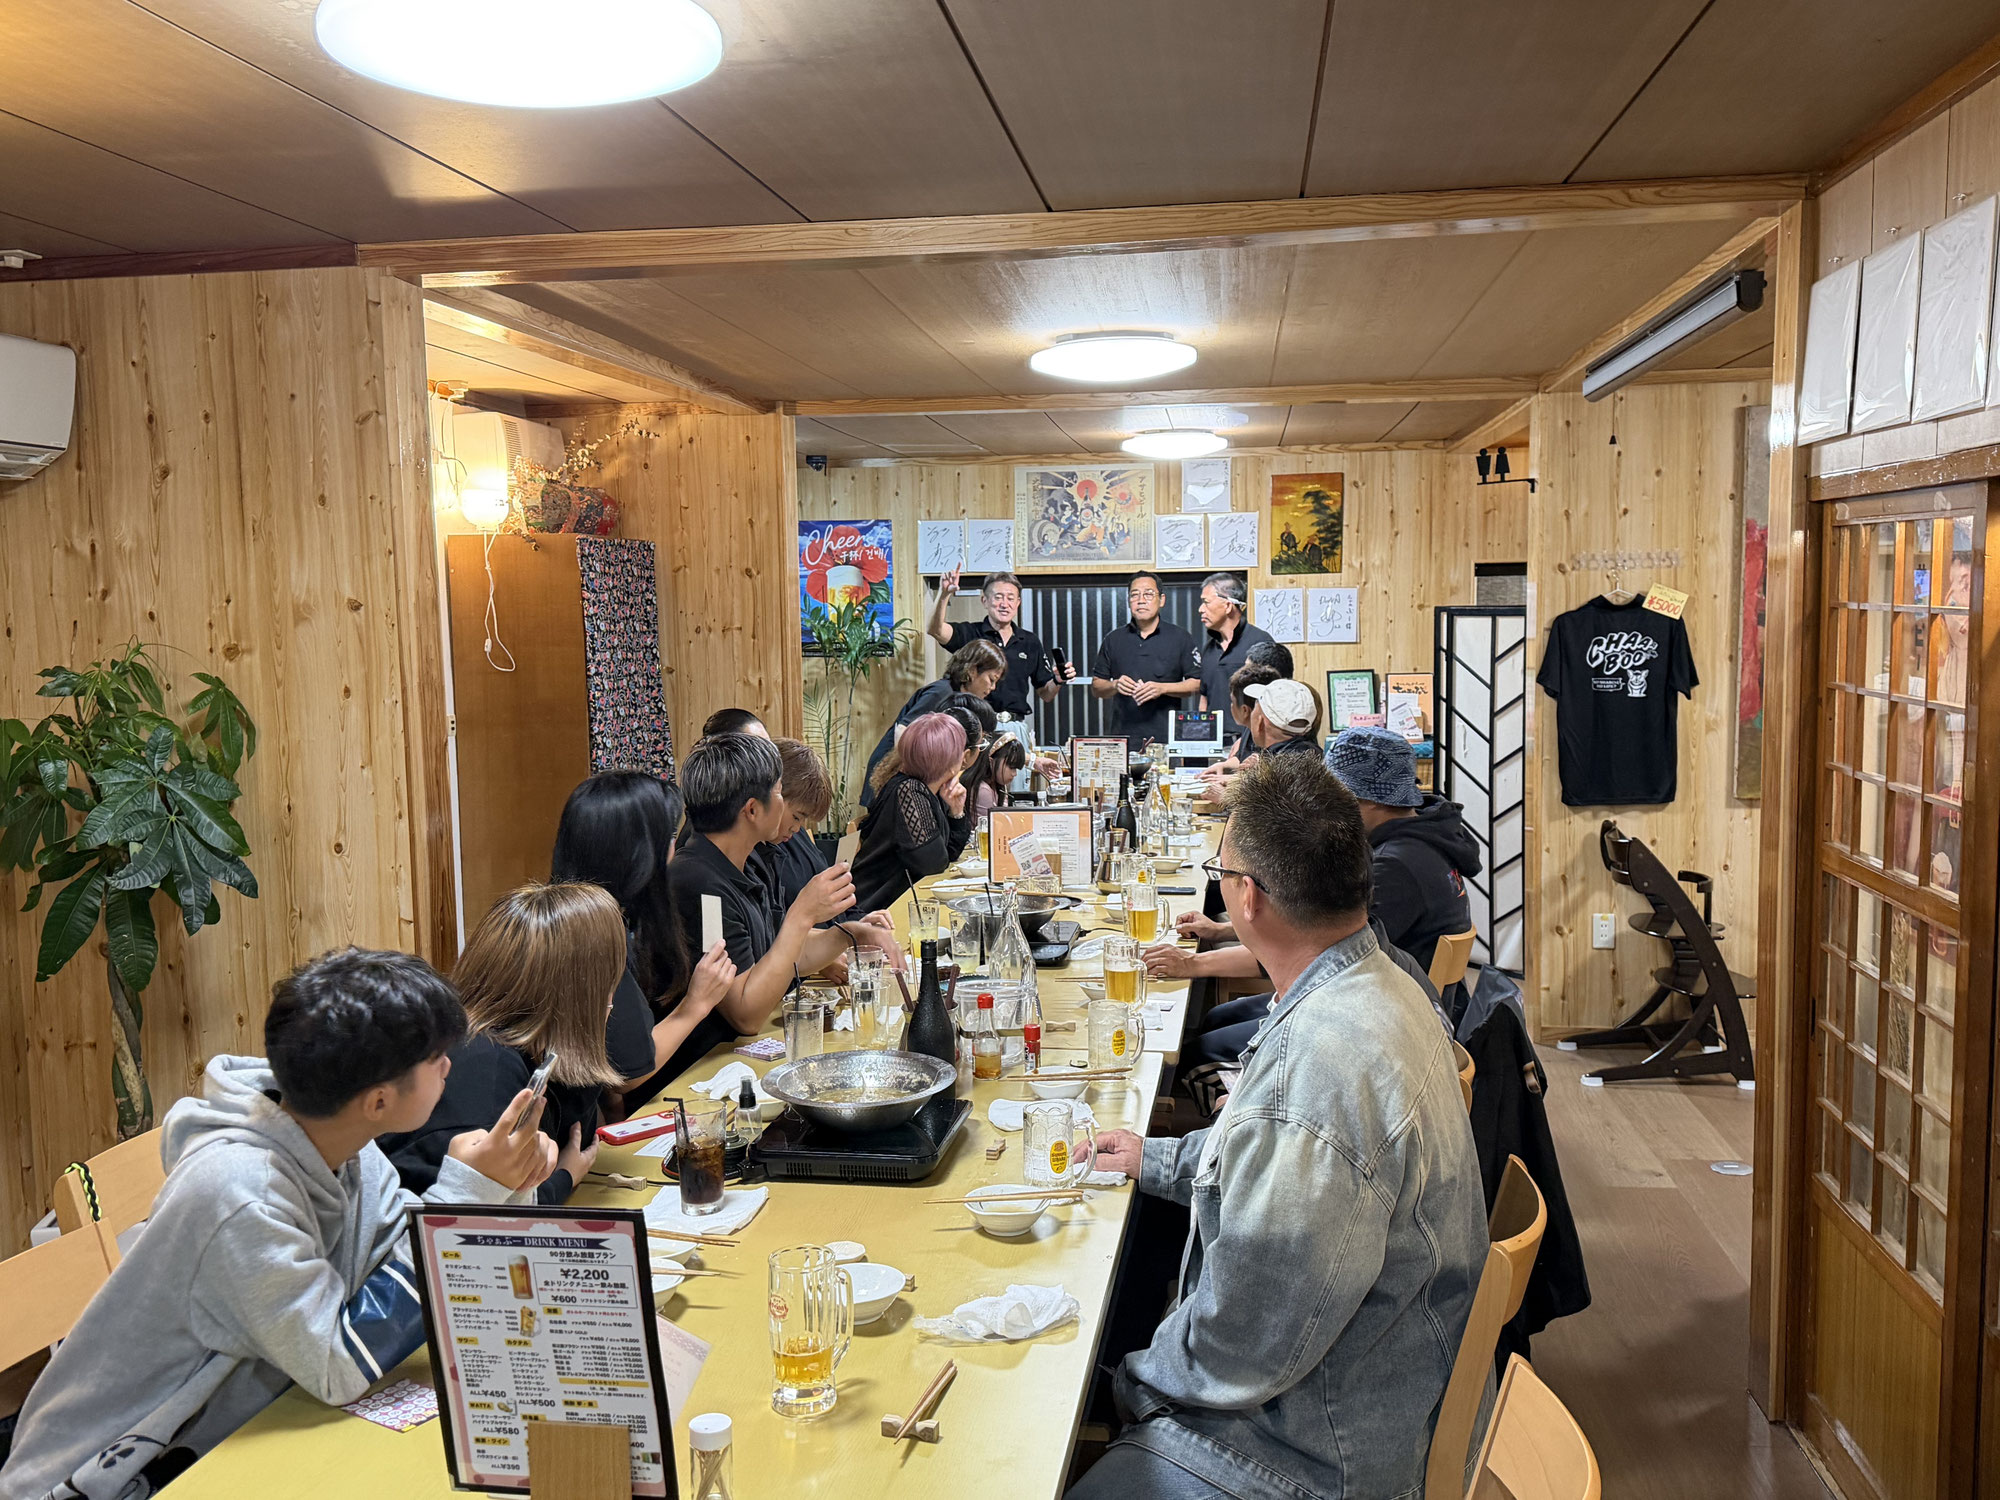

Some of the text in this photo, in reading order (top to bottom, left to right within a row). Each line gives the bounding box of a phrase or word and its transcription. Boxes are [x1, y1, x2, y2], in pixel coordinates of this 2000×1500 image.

[805, 524, 884, 565] Cheers!
[1648, 595, 1681, 615] ¥5000
[524, 1237, 557, 1247] DRINK
[558, 1239, 588, 1248] MENU
[549, 1251, 616, 1259] 90分飲み放題プラン
[560, 1268, 610, 1281] ¥2,200
[551, 1295, 577, 1303] ¥600
[519, 1399, 556, 1407] ALL¥500
[483, 1427, 519, 1435] ALL¥580
